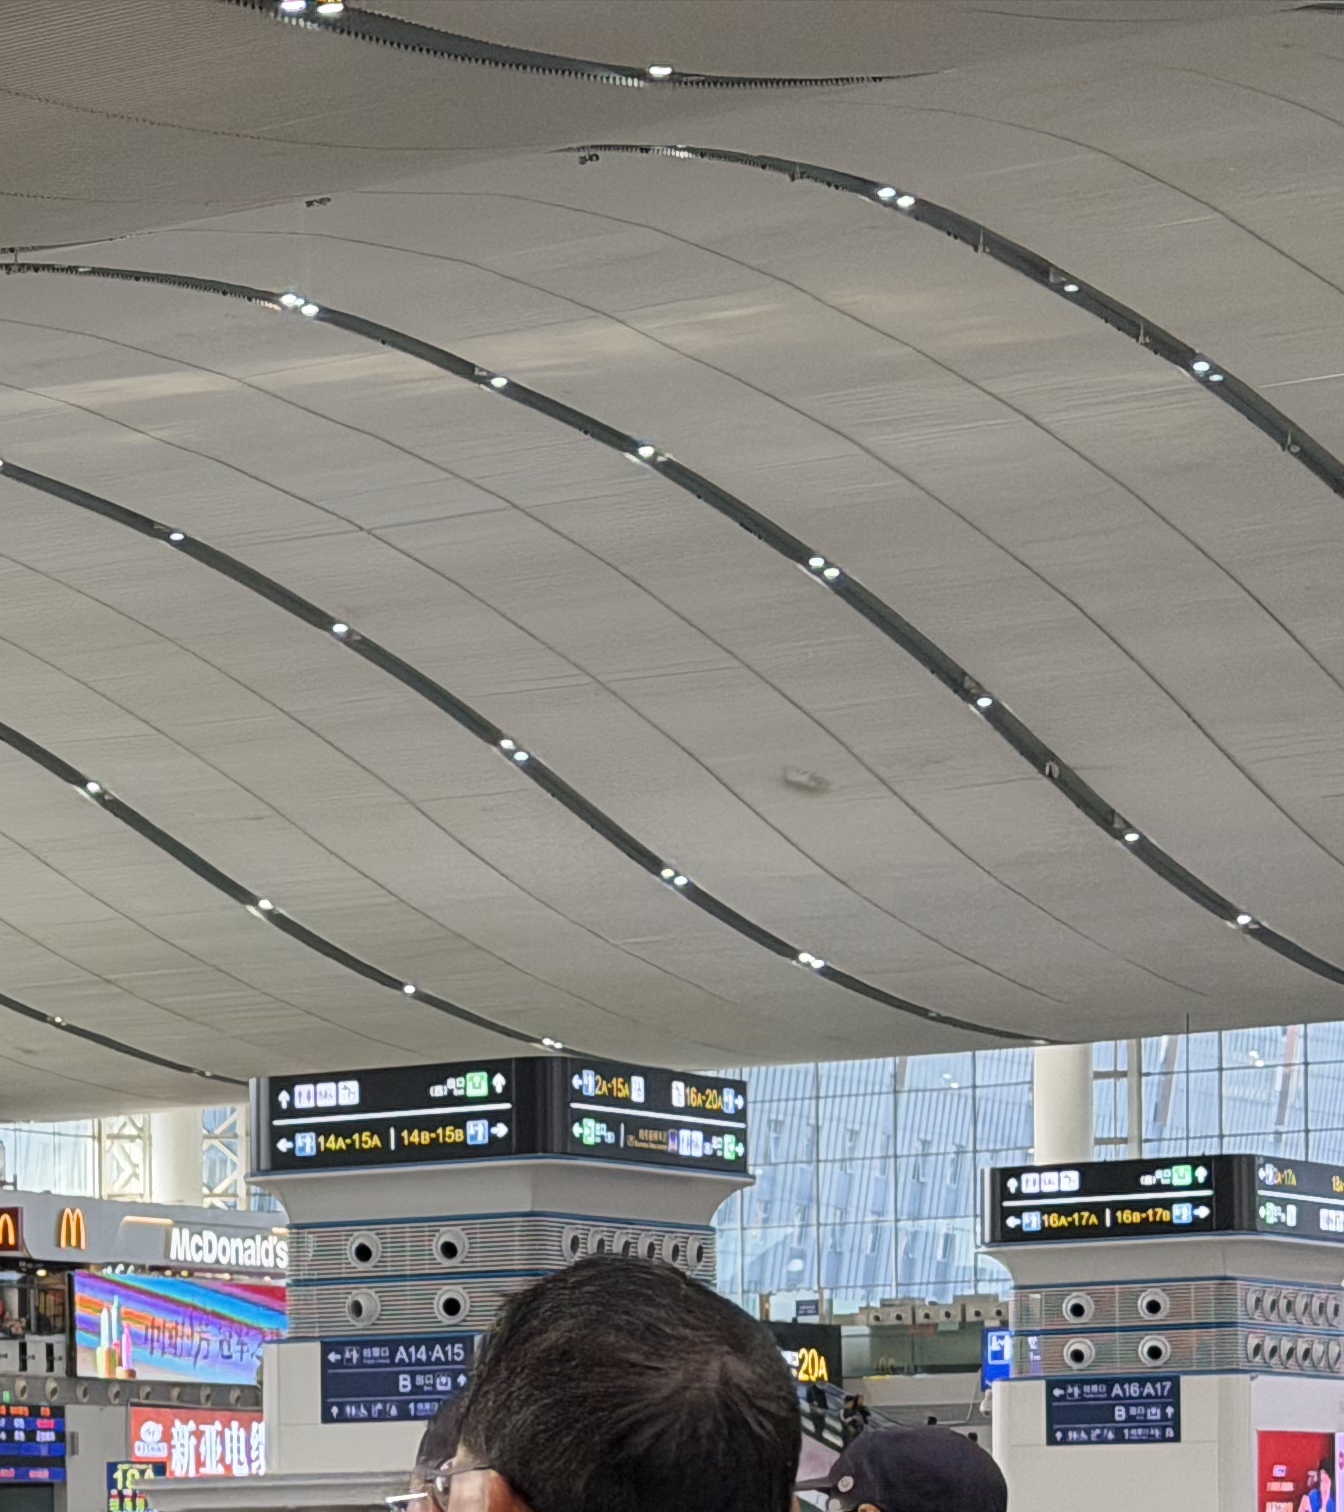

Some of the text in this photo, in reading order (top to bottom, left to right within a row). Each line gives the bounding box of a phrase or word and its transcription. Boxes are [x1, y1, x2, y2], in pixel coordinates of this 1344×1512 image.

[317, 1131, 382, 1152] 14A-15A
[401, 1126, 464, 1146] 14B-15B
[1041, 1211, 1098, 1229] 16A-17A
[170, 1228, 288, 1269] McDonald's
[798, 1347, 828, 1382] 20A
[399, 1374, 411, 1393] B
[1115, 1406, 1126, 1421] B
